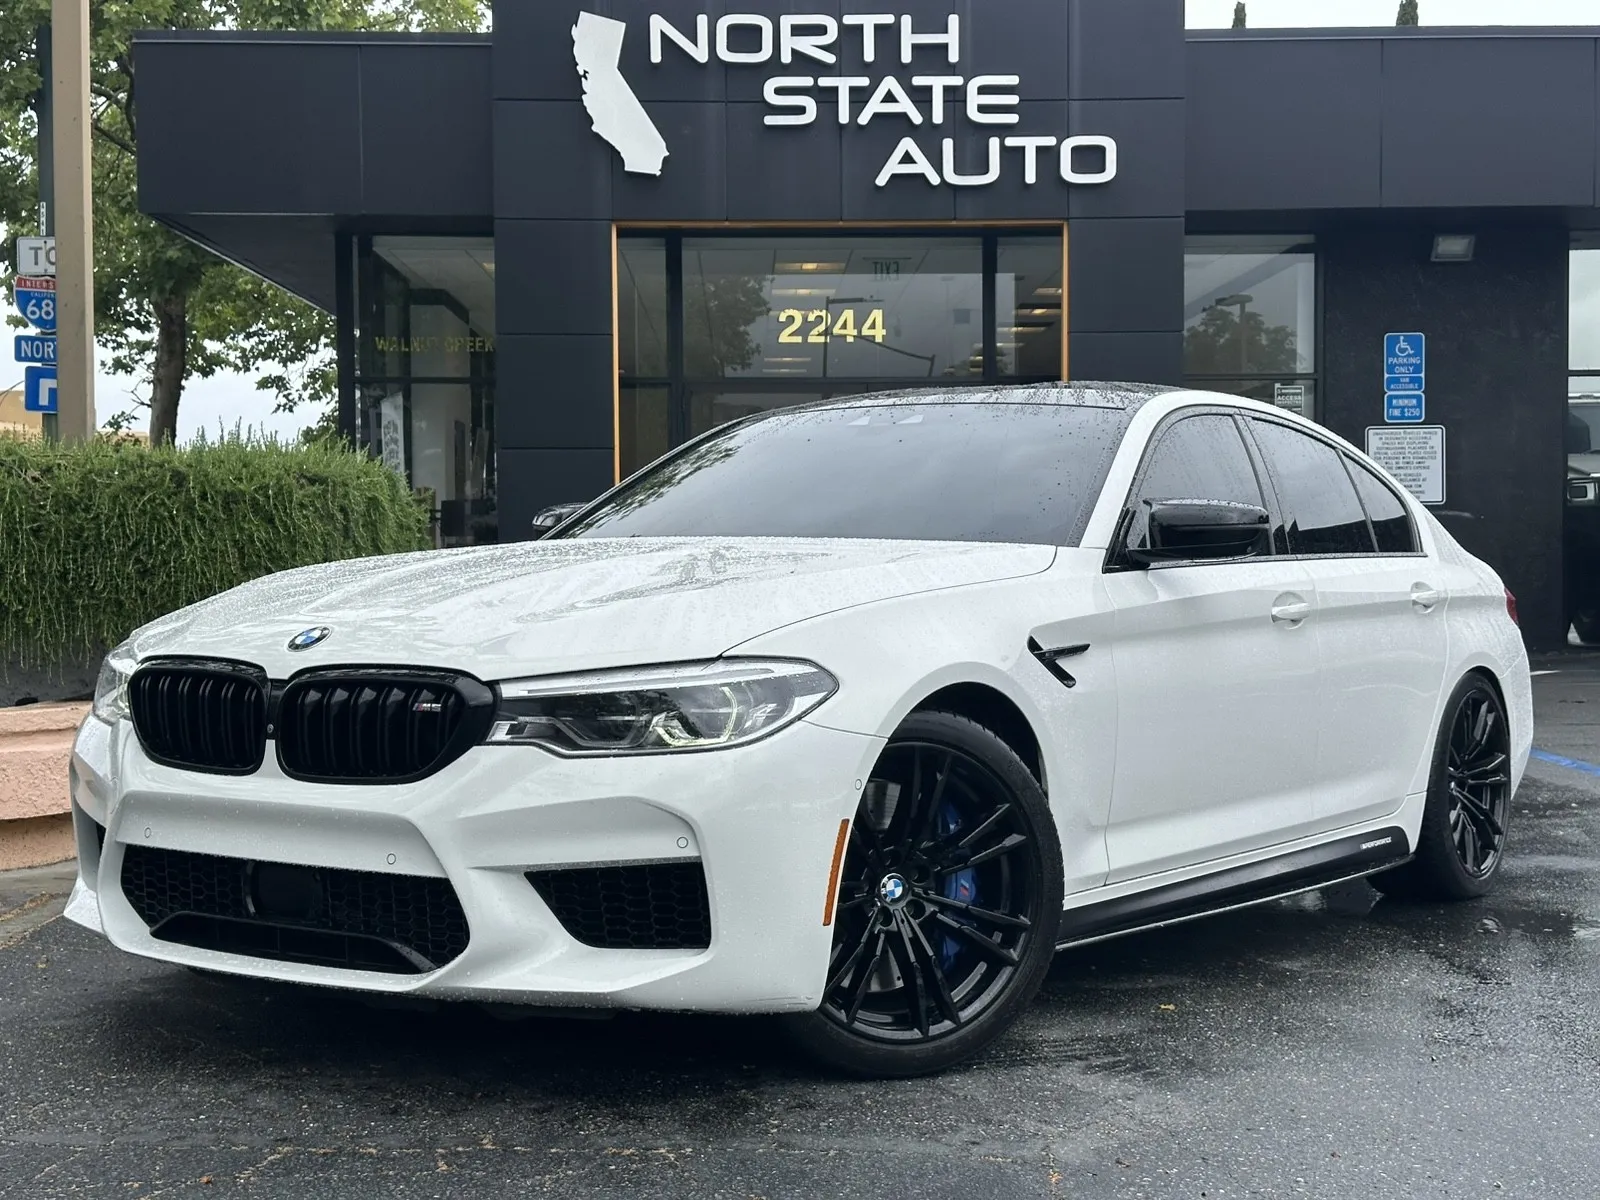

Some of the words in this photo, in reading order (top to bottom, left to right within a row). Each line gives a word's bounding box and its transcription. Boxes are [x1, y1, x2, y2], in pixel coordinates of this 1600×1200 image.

[649, 13, 960, 64] NORTH
[763, 74, 1020, 126] STATE
[875, 135, 1117, 187] AUTO
[29, 246, 56, 267] TO
[21, 279, 55, 289] INTERS
[26, 299, 55, 320] 68
[778, 308, 887, 343] 2244
[20, 340, 56, 359] NOR
[1388, 357, 1421, 365] PARKING
[1389, 408, 1402, 417] FINE
[1404, 408, 1420, 417] $250
